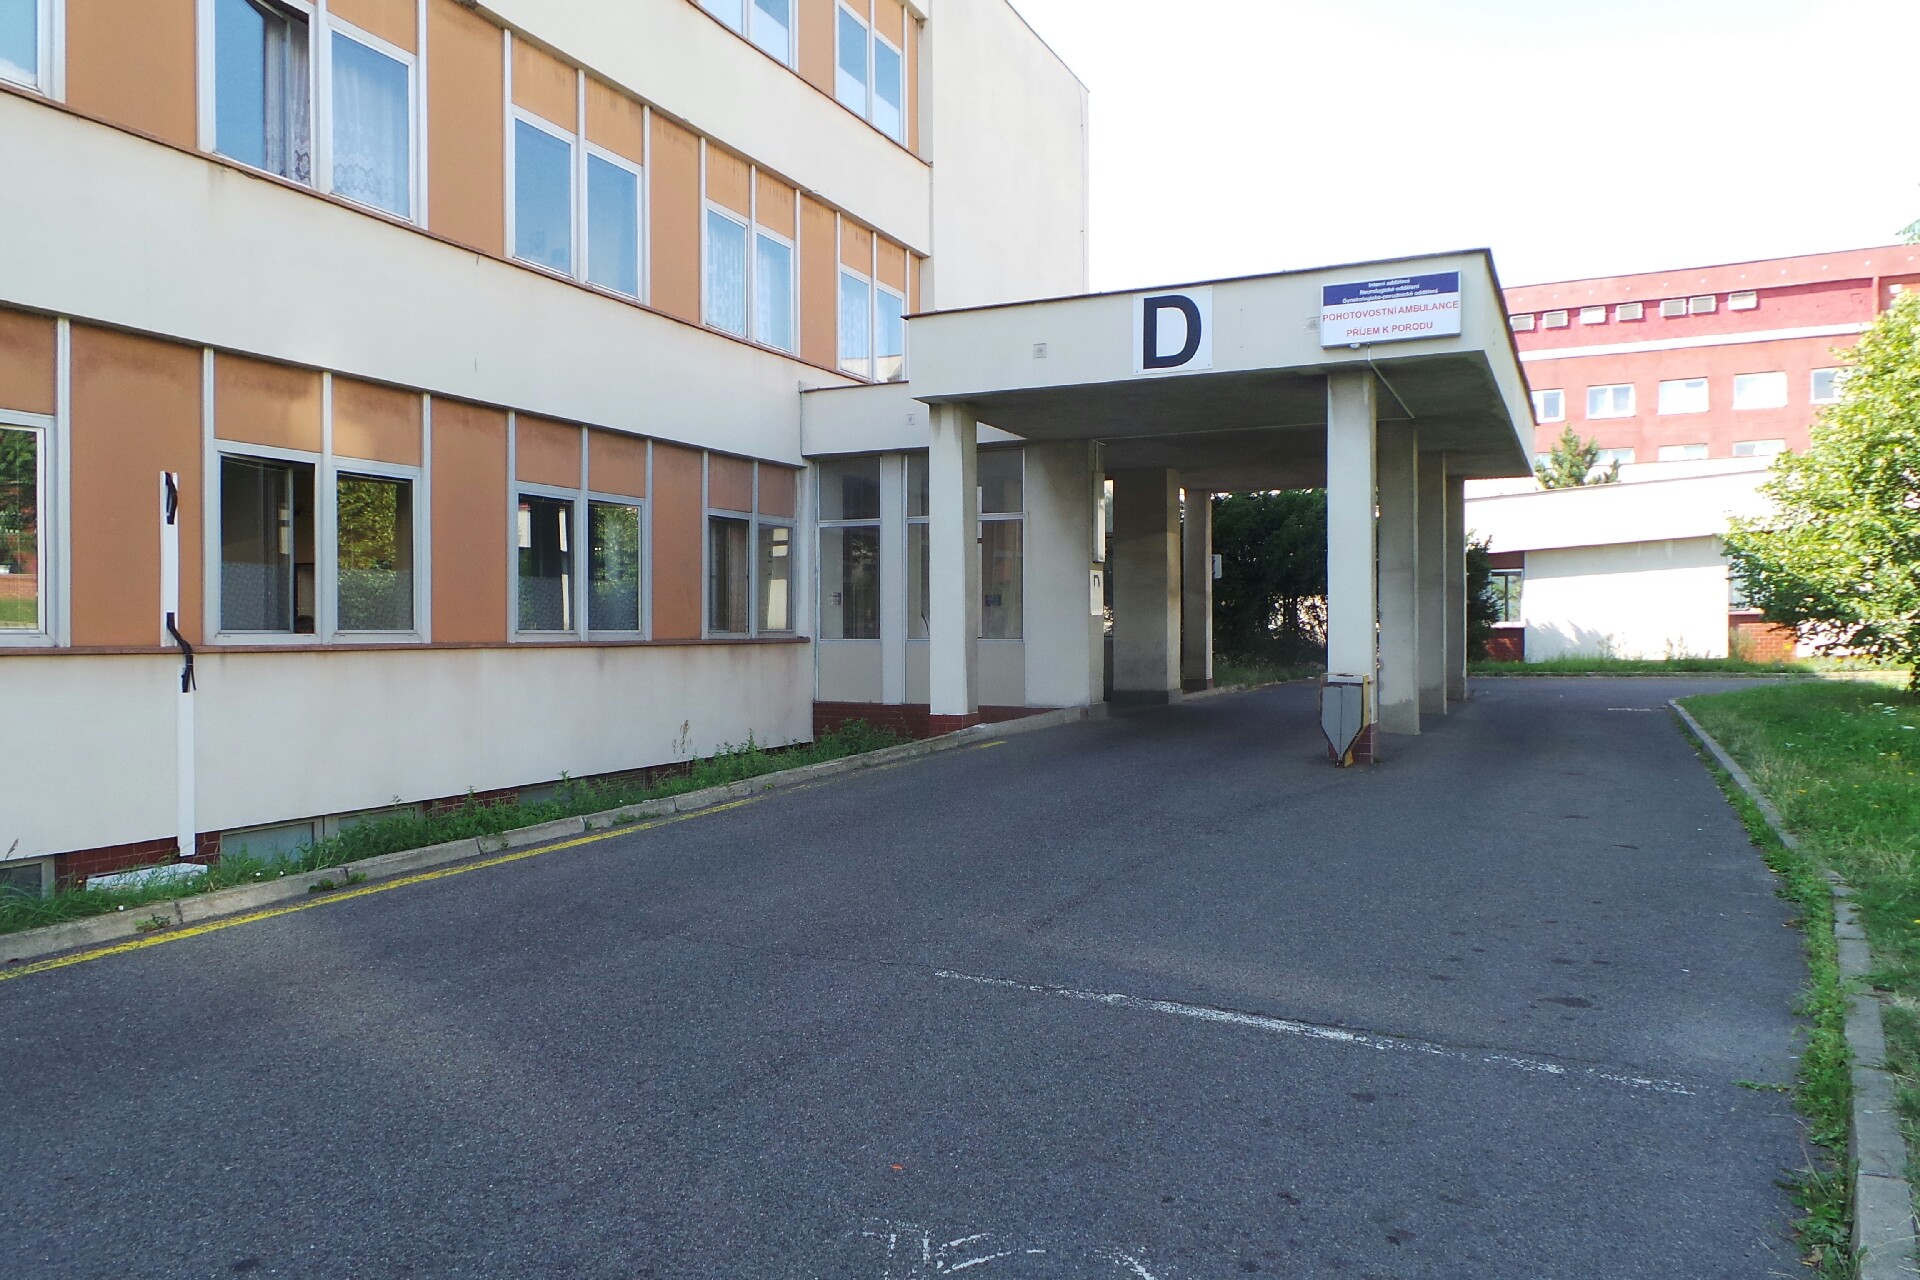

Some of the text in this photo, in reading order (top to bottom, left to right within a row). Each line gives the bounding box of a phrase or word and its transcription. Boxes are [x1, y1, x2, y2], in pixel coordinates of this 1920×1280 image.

[1359, 283, 1420, 296] Neurologické oddělení
[1414, 287, 1439, 297] oddělení
[1323, 300, 1459, 322] POHOTOVOSTNÍ AMBULANCE
[1143, 295, 1202, 369] D
[1382, 326, 1389, 334] K
[1391, 321, 1433, 333] PORODU
